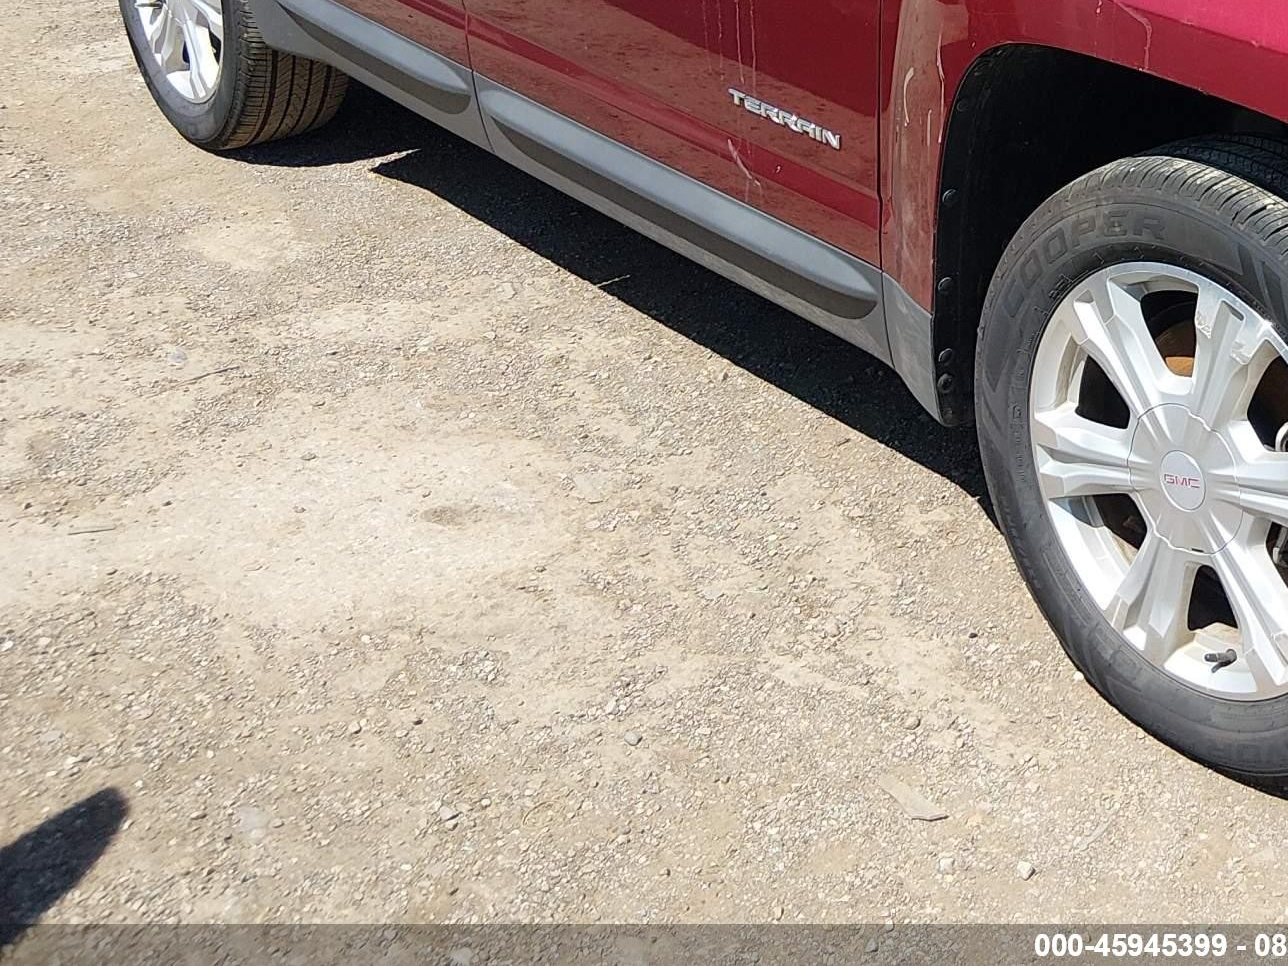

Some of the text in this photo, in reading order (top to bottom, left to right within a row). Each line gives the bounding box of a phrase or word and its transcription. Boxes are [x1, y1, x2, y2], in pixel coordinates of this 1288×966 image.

[727, 87, 842, 151] TERRAIN
[1003, 209, 1166, 318] COOPER
[1163, 473, 1201, 489] GMC
